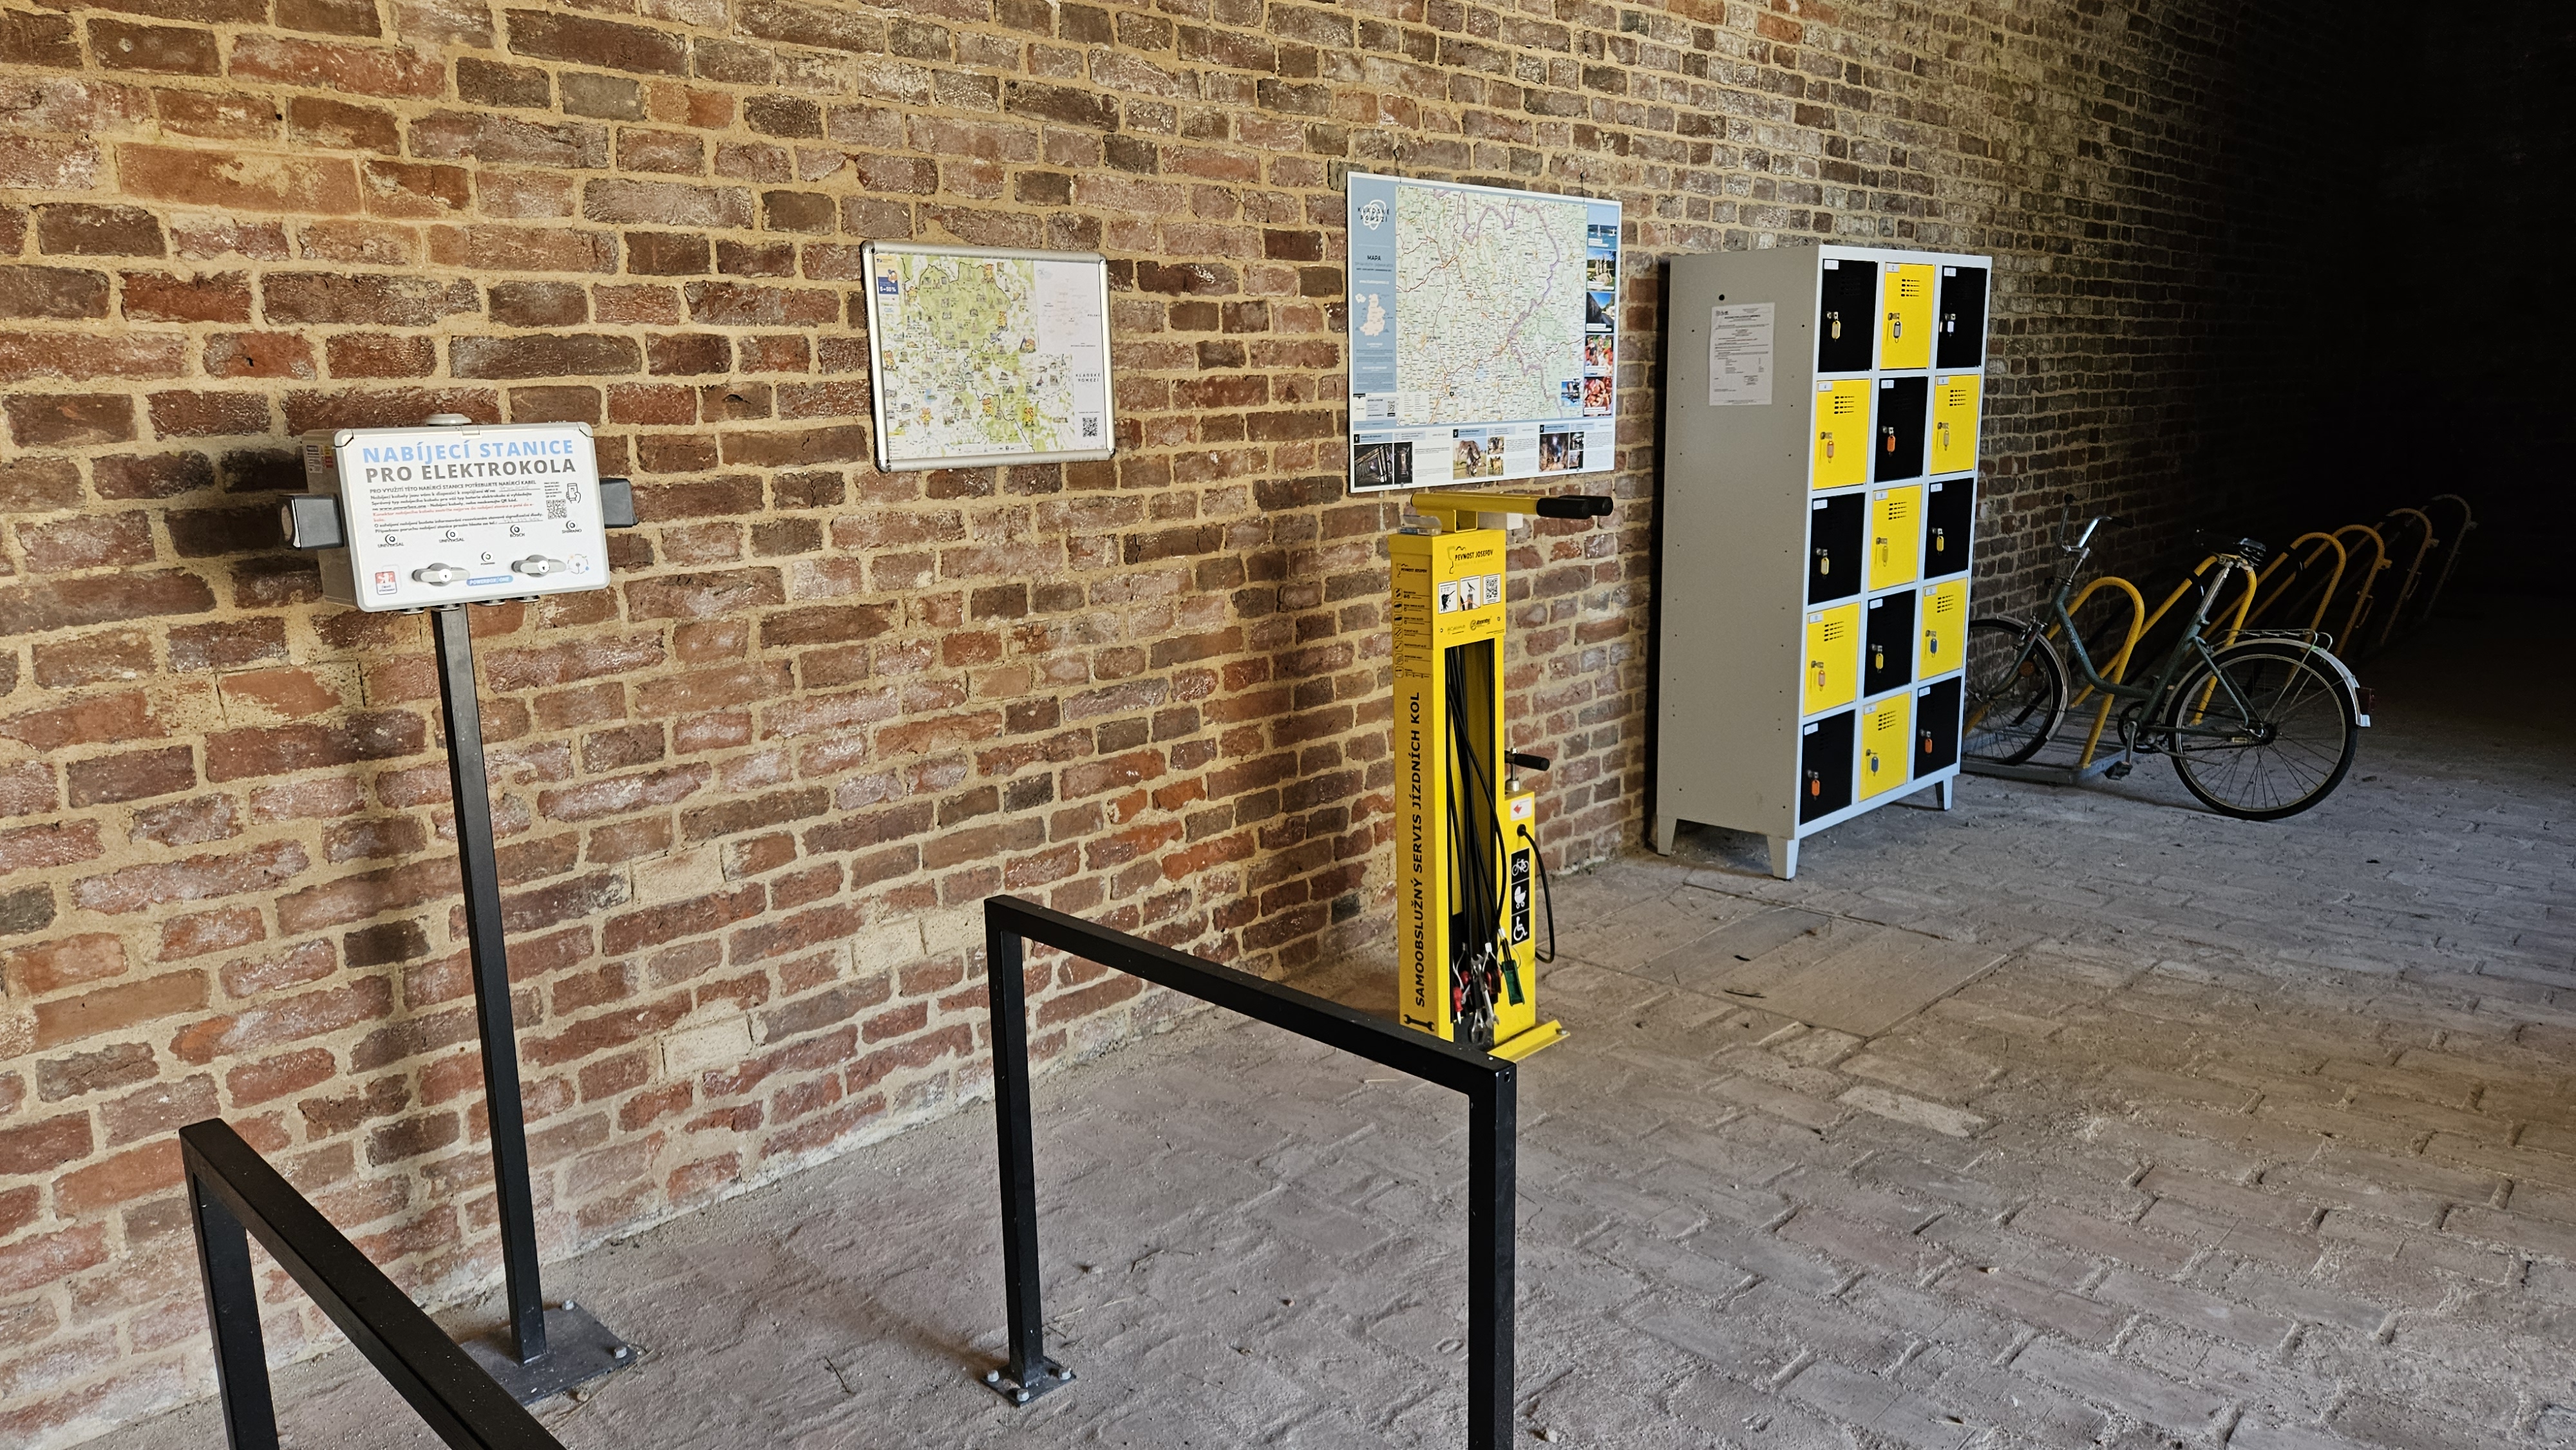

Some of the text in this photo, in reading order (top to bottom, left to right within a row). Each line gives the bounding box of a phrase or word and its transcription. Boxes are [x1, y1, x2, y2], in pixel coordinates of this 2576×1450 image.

[363, 440, 573, 465] NABÍJECÍ STANICE
[366, 459, 576, 483] PRO ELEKTROKOLA
[1455, 549, 1493, 561] PEVNOST JOSEFOV
[1409, 692, 1425, 1008] SAMOOBSLUŽNÝ SERVIS JÍZDNÍCH KOL
